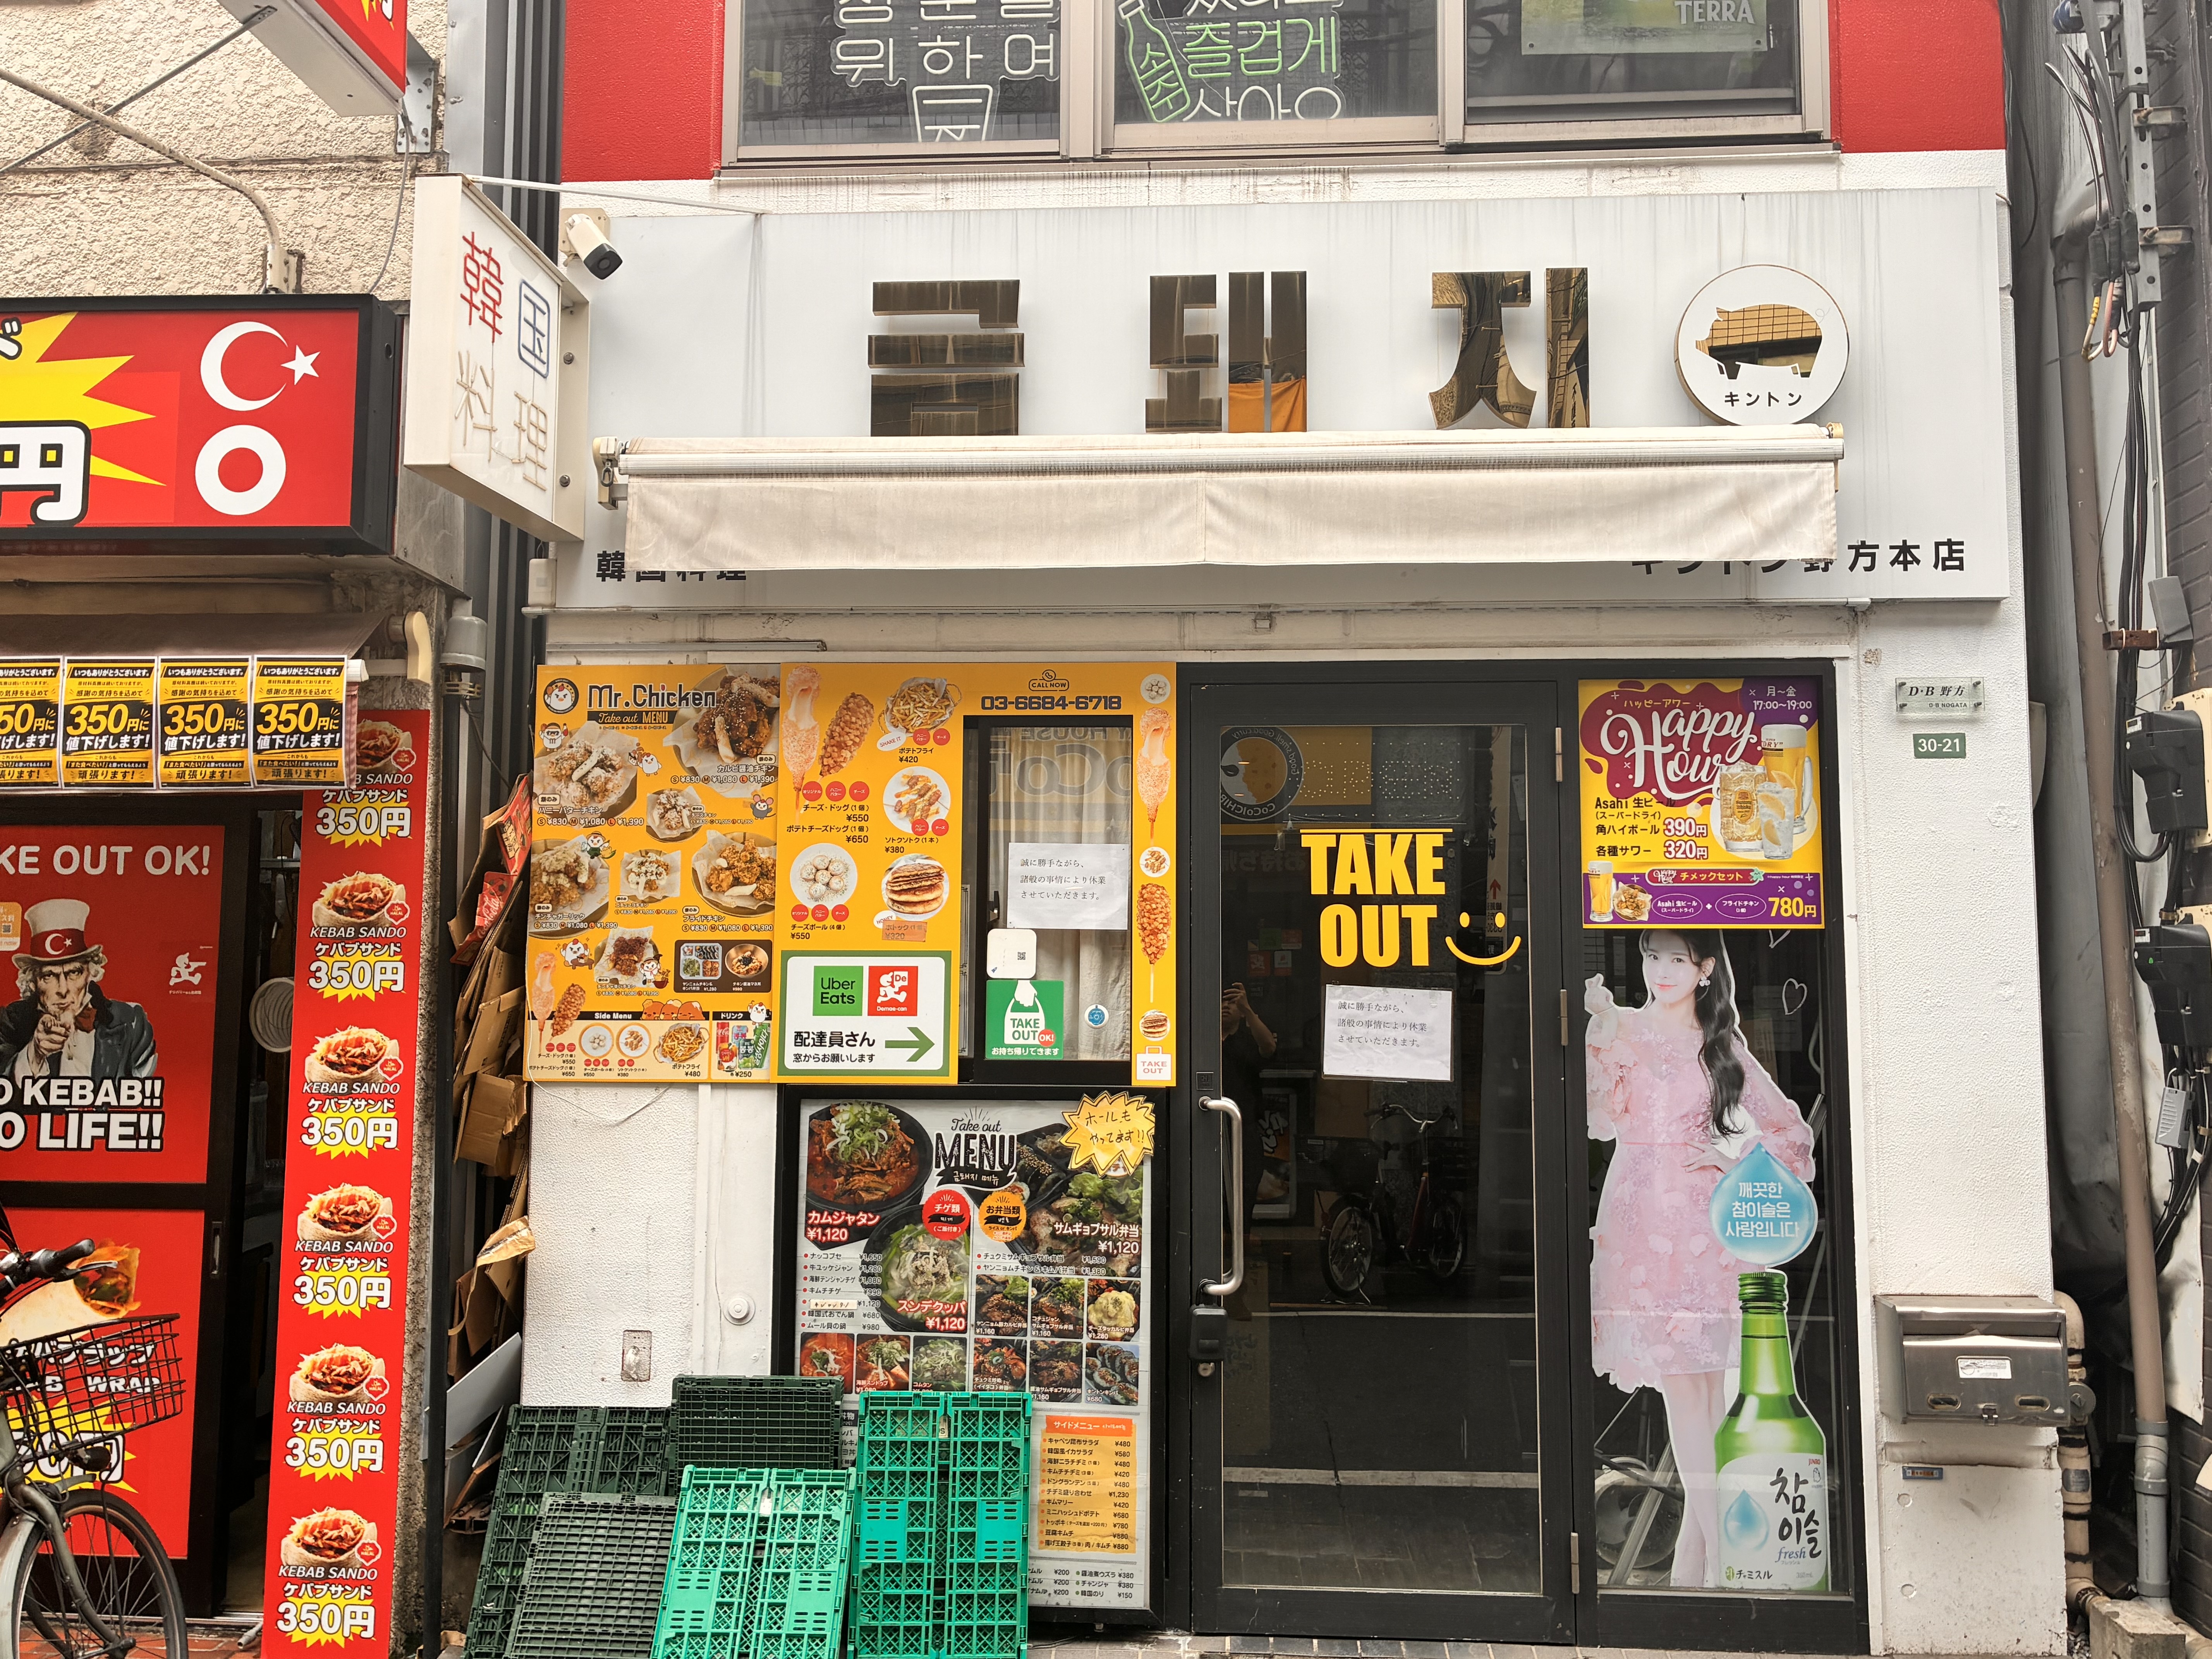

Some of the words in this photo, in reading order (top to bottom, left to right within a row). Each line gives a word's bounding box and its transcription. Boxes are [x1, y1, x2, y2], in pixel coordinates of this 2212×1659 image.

[1674, 0, 1755, 24] TERRA
[1183, 17, 1336, 78] 즐겁게
[836, 33, 1053, 82] 위하여
[1724, 392, 1802, 407] キントン
[1940, 685, 1965, 697] 野方
[981, 696, 1122, 710] 03-6684-6718
[1624, 699, 1691, 708] ハッピーアワー
[66, 704, 149, 735] 350円に
[164, 703, 245, 735] 350円に
[598, 713, 622, 723] Take
[623, 714, 639, 723] out
[642, 711, 669, 723] MENU
[880, 738, 896, 747] SHAKE
[1917, 738, 1960, 753] 30-21
[365, 774, 413, 785] SANDO
[322, 789, 407, 804] ケバブサンド
[1595, 797, 1628, 809] Asahi
[1633, 797, 1676, 808] 生ビール
[315, 806, 411, 838] 350円
[846, 814, 869, 822] ¥550
[1595, 824, 1660, 835] 角ハイボール
[1663, 817, 1708, 837] 390円
[845, 835, 869, 843] ¥650
[1596, 846, 1651, 857] 各種サワー
[1664, 840, 1708, 860] 320円
[53, 845, 133, 875] OUT
[144, 845, 210, 876] OK!
[1301, 833, 1446, 895] TAKE
[1020, 875, 1106, 885] 諸般の事情により休業
[1680, 872, 1743, 881] チメックセット
[1768, 897, 1817, 917] 780円
[310, 927, 356, 938] KEBAB
[358, 927, 406, 938] SANDO
[1319, 903, 1437, 968] OUT
[315, 942, 402, 957] ケバブサンド
[308, 960, 405, 992] 350円
[895, 974, 907, 982] De
[821, 977, 855, 991] Uber
[820, 993, 855, 1005] Eats
[1010, 1018, 1040, 1029] TAKE
[1337, 1018, 1427, 1032] 諸般の事情により休業
[793, 1030, 876, 1048] 配達員さん
[1012, 1030, 1038, 1040] OUT
[1039, 1034, 1054, 1042] OK!
[793, 1052, 876, 1063] 窓からお願いします
[991, 1048, 1059, 1056] お持ち帰りできます
[23, 1079, 161, 1106] KEBAB!!
[951, 1118, 980, 1132] Take
[982, 1121, 1001, 1132] out
[1085, 1111, 1131, 1126] ホールも
[38, 1113, 161, 1149] LIFE!!
[934, 1133, 1015, 1171] MENU
[953, 1170, 978, 1182] 금돼지
[981, 1174, 1000, 1186] 메뉴
[1738, 1181, 1784, 1200] 깨끗한
[934, 1203, 960, 1213] チゲ類
[986, 1206, 1020, 1215] お弁当類
[1731, 1201, 1791, 1219] 참이슬은
[807, 1211, 880, 1225] カムジャタン
[807, 1228, 848, 1241] ¥1,120
[1054, 1222, 1139, 1238] サムギョプサル弁当
[1725, 1221, 1800, 1239] 사랑입니다
[294, 1241, 341, 1253] KEBAB
[344, 1240, 393, 1253] SANDO
[1098, 1241, 1139, 1254] ¥1,120
[300, 1256, 388, 1272] ケバブサンド
[1082, 1255, 1106, 1264] ¥1,590
[293, 1275, 392, 1309] 350円
[897, 1300, 967, 1314] スンデクッパ
[926, 1317, 965, 1330] ¥1,120
[1053, 1421, 1100, 1430] サイドメニュー
[1775, 1547, 1806, 1563] fresh
[278, 1565, 325, 1579] KEBAB
[328, 1566, 378, 1581] SANDO
[1736, 1570, 1772, 1579] チャミスル
[283, 1583, 372, 1600] ケバブサンド
[276, 1602, 376, 1639] 350円
